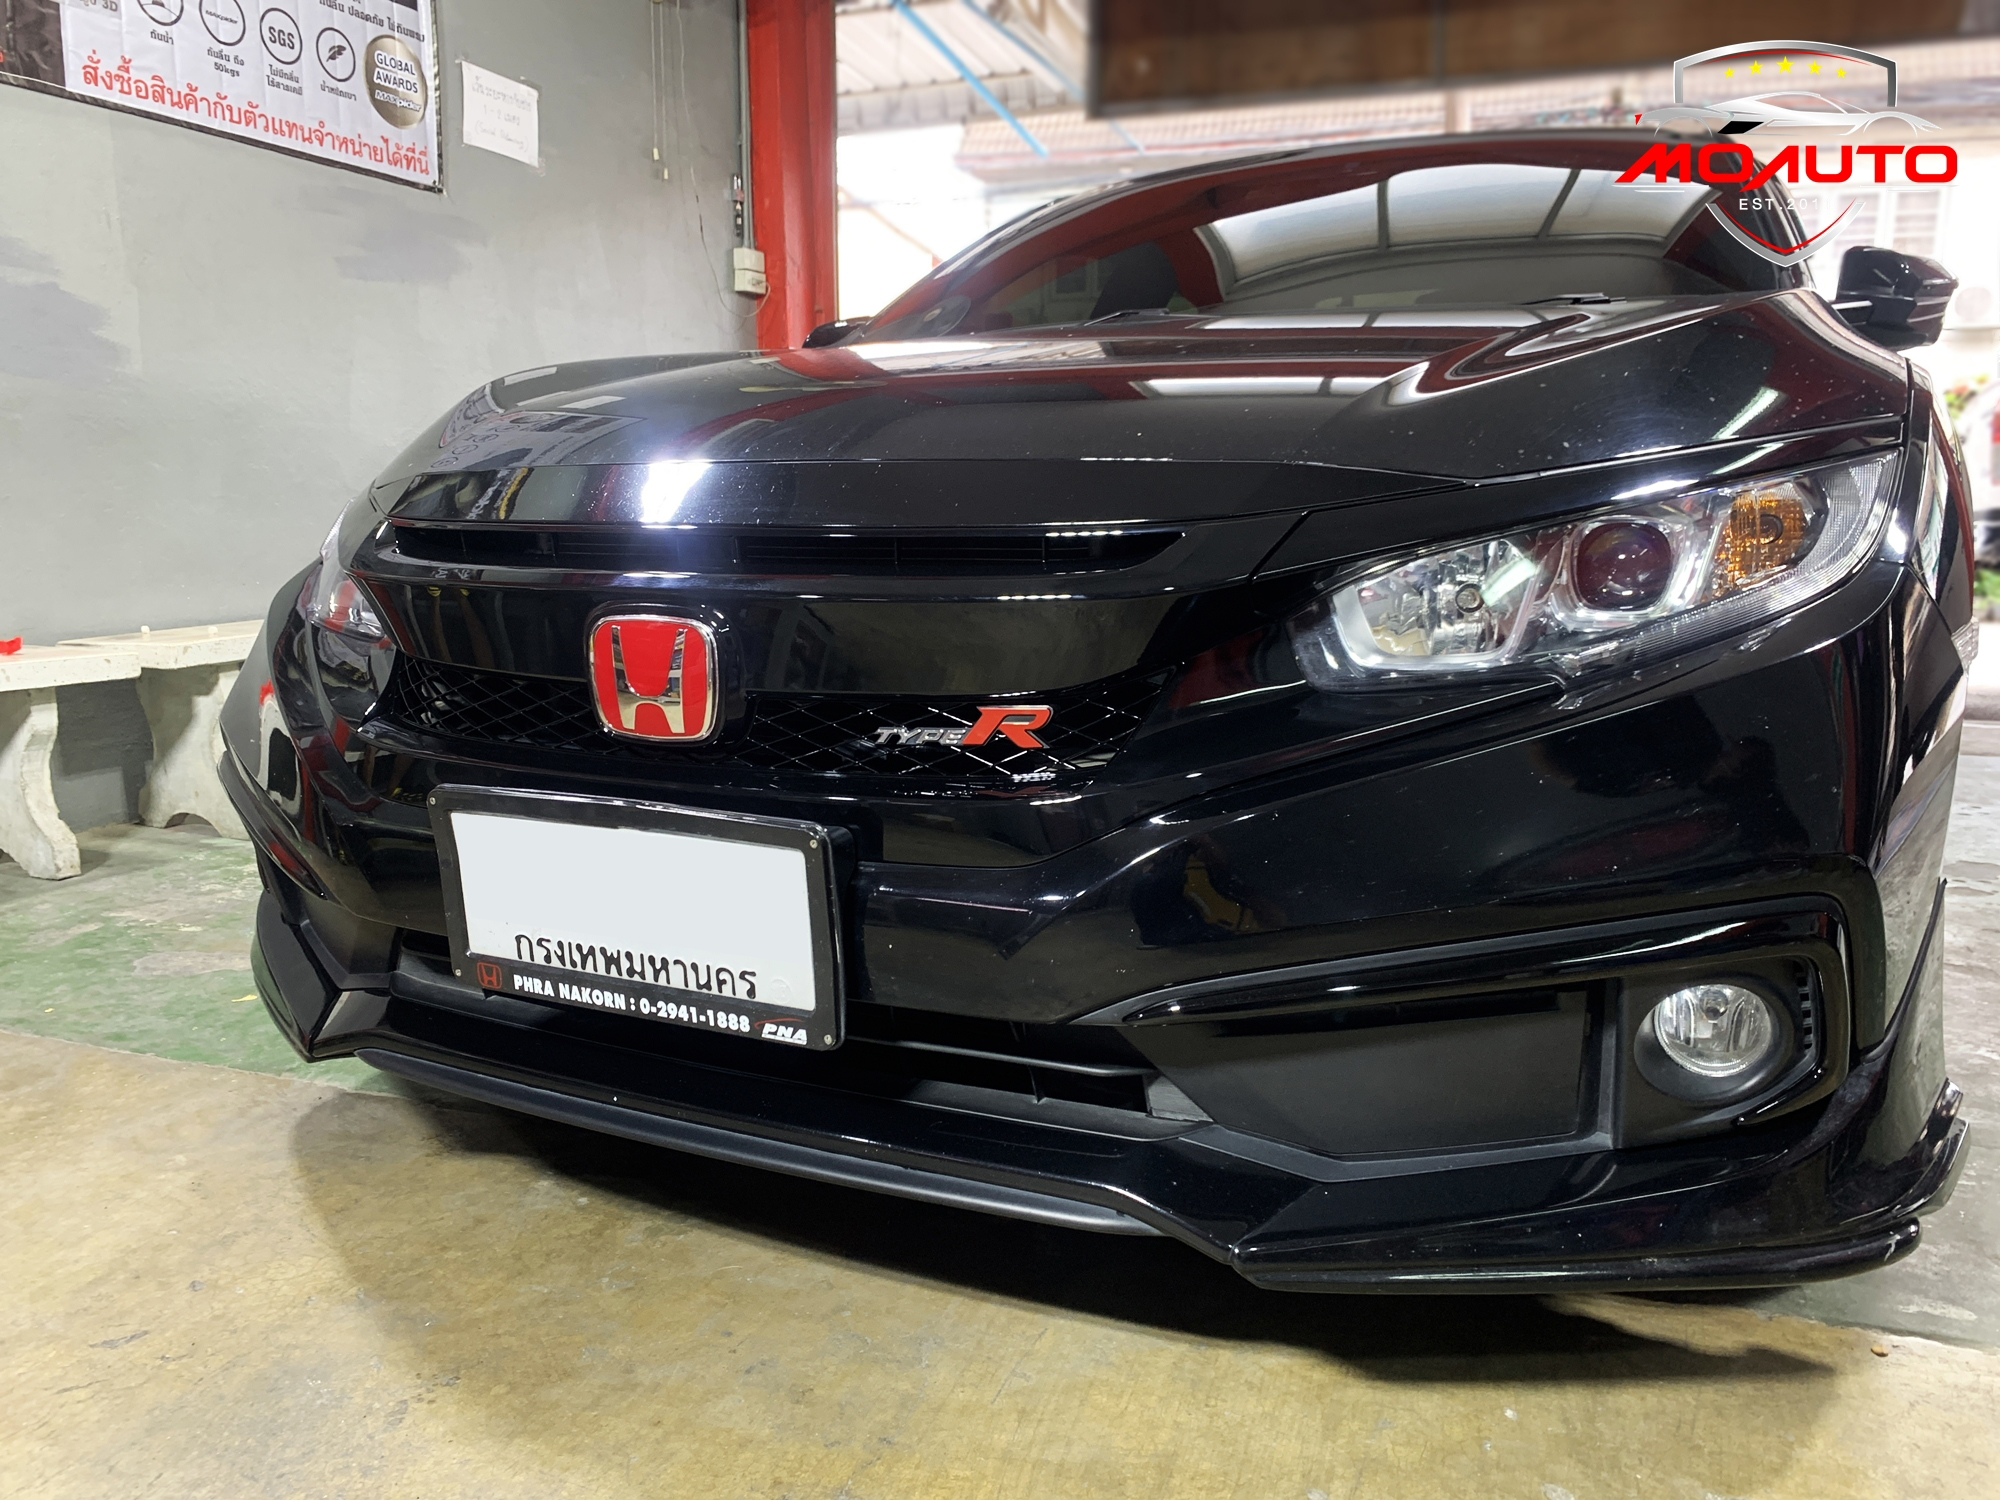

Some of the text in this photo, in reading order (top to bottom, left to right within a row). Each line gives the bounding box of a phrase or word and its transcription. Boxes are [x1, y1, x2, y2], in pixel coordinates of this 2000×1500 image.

[268, 26, 295, 50] SGS
[376, 52, 416, 76] GLOBAL
[375, 70, 418, 94] AWARDS
[875, 727, 968, 746] TYPE
[515, 934, 757, 999] กรงเทพมหานคร
[513, 974, 555, 997] PHRA
[558, 982, 627, 1010] NAKORN
[639, 998, 750, 1032] 0-2941-1888
